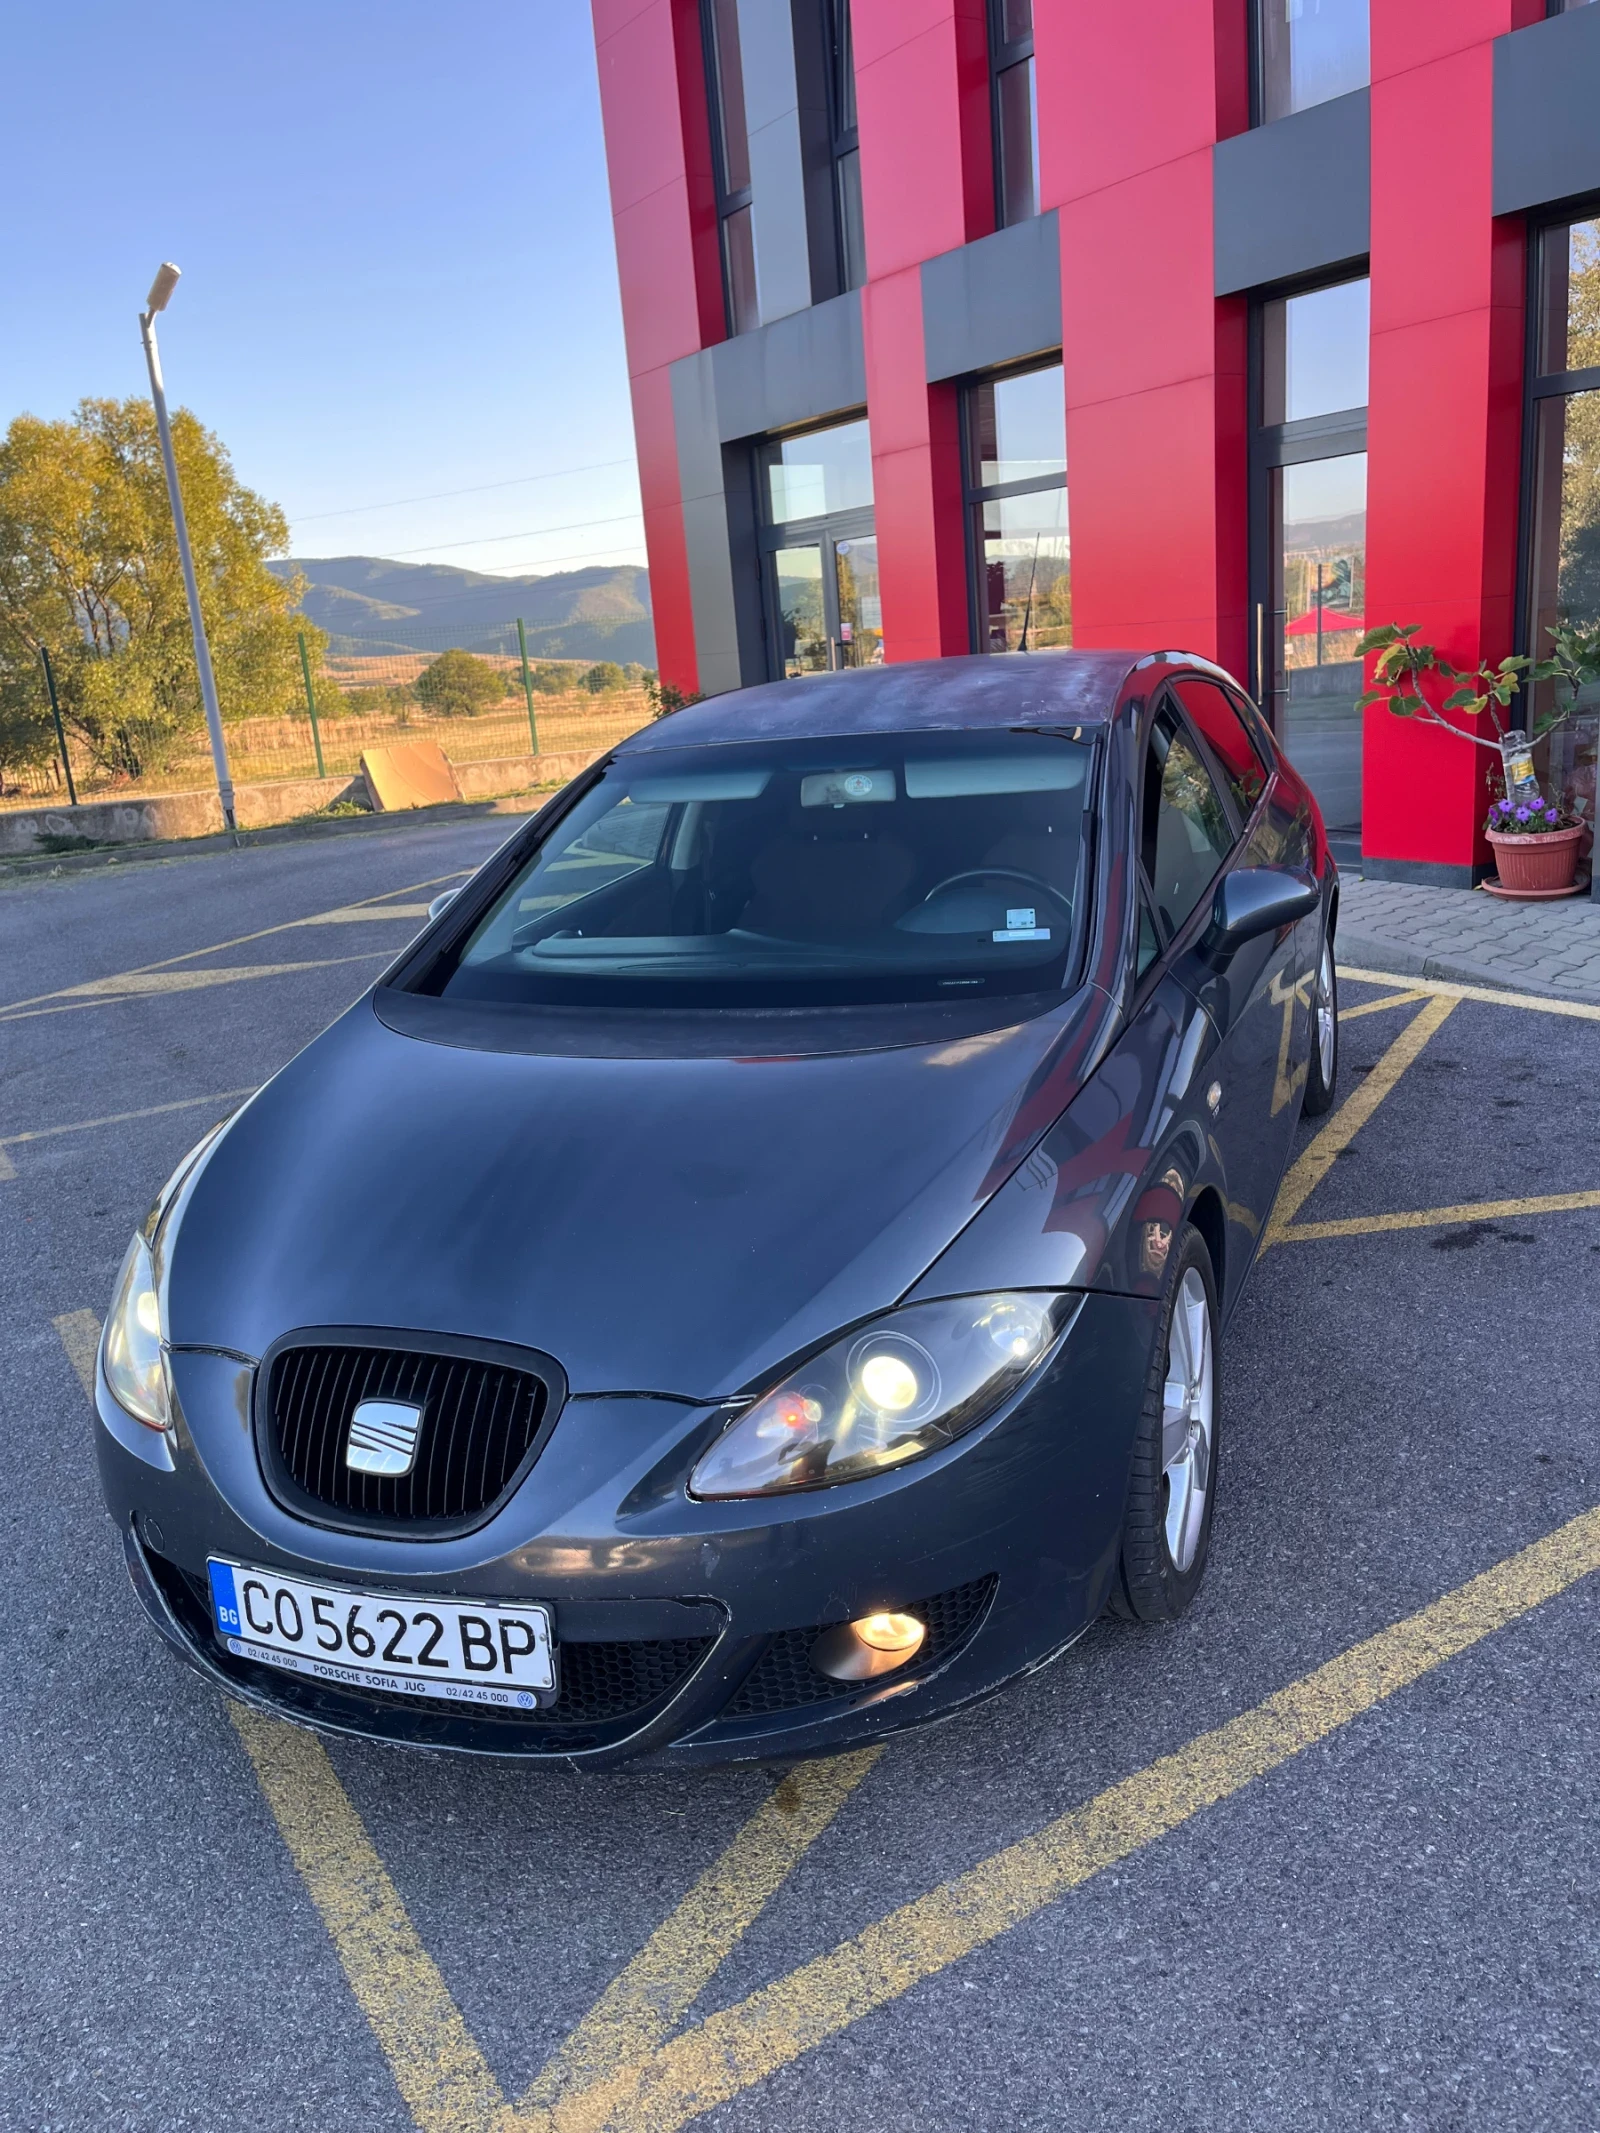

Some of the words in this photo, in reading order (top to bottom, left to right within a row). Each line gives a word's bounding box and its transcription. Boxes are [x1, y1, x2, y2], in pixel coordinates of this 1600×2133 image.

[220, 1606, 238, 1625] BG
[247, 1648, 269, 1661] 02/42
[270, 1653, 281, 1664] 45
[283, 1657, 298, 1667] 000
[313, 1665, 361, 1683] PORSCHE
[366, 1674, 397, 1689] SOFIA
[404, 1681, 426, 1693] JUG
[446, 1687, 475, 1700] 02/42
[476, 1691, 488, 1701] 45
[490, 1692, 508, 1703] 000
